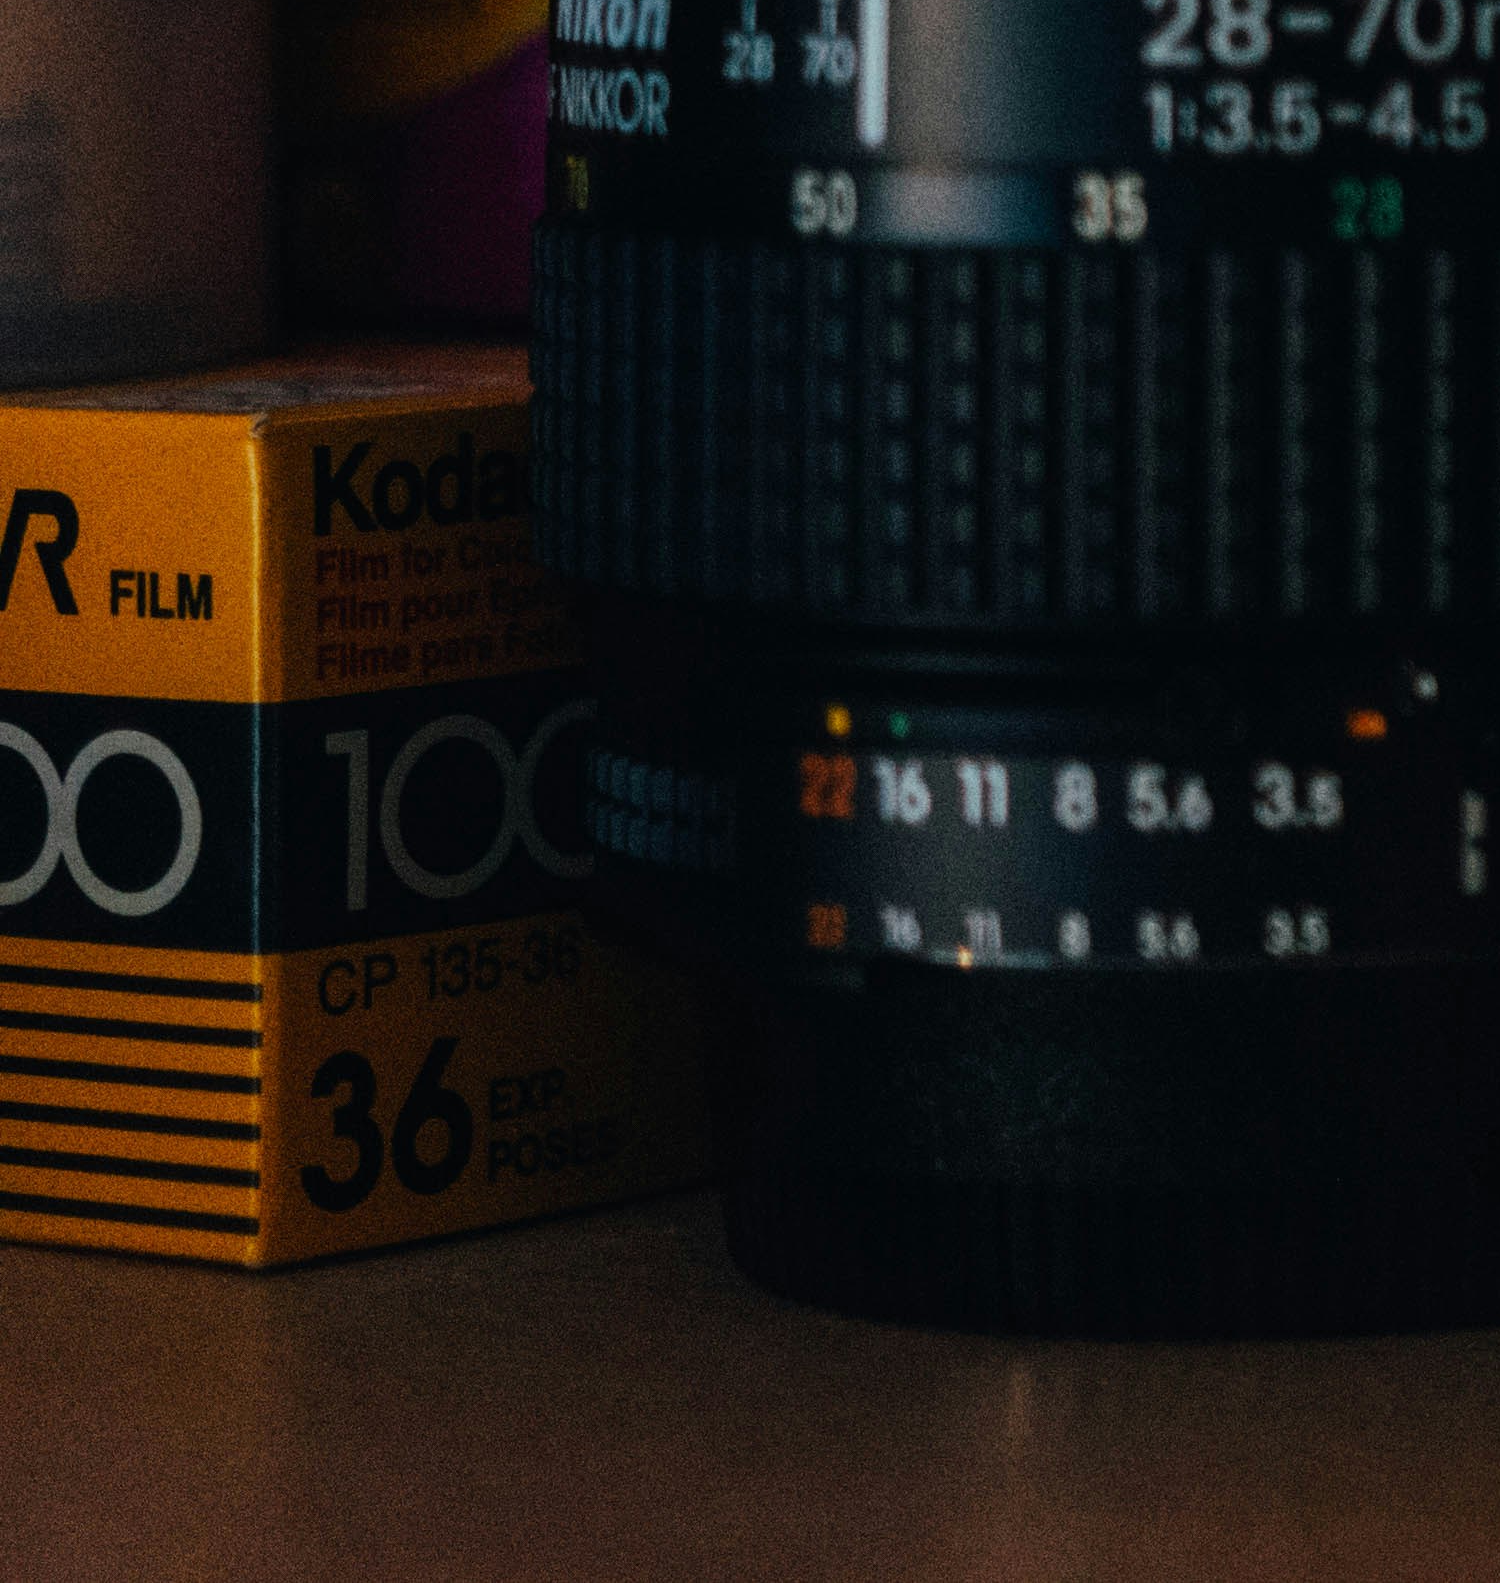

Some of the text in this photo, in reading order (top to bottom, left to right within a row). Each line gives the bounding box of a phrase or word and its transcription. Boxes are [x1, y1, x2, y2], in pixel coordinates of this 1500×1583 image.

[792, 166, 858, 237] 50
[1072, 170, 1148, 244] 35
[312, 432, 534, 537] Koda
[109, 569, 213, 620] FILM
[315, 547, 390, 586] Film
[316, 595, 390, 633] Film
[1054, 761, 1098, 831] 8
[317, 924, 581, 1017] CP 135-36
[302, 1037, 473, 1212] 36
